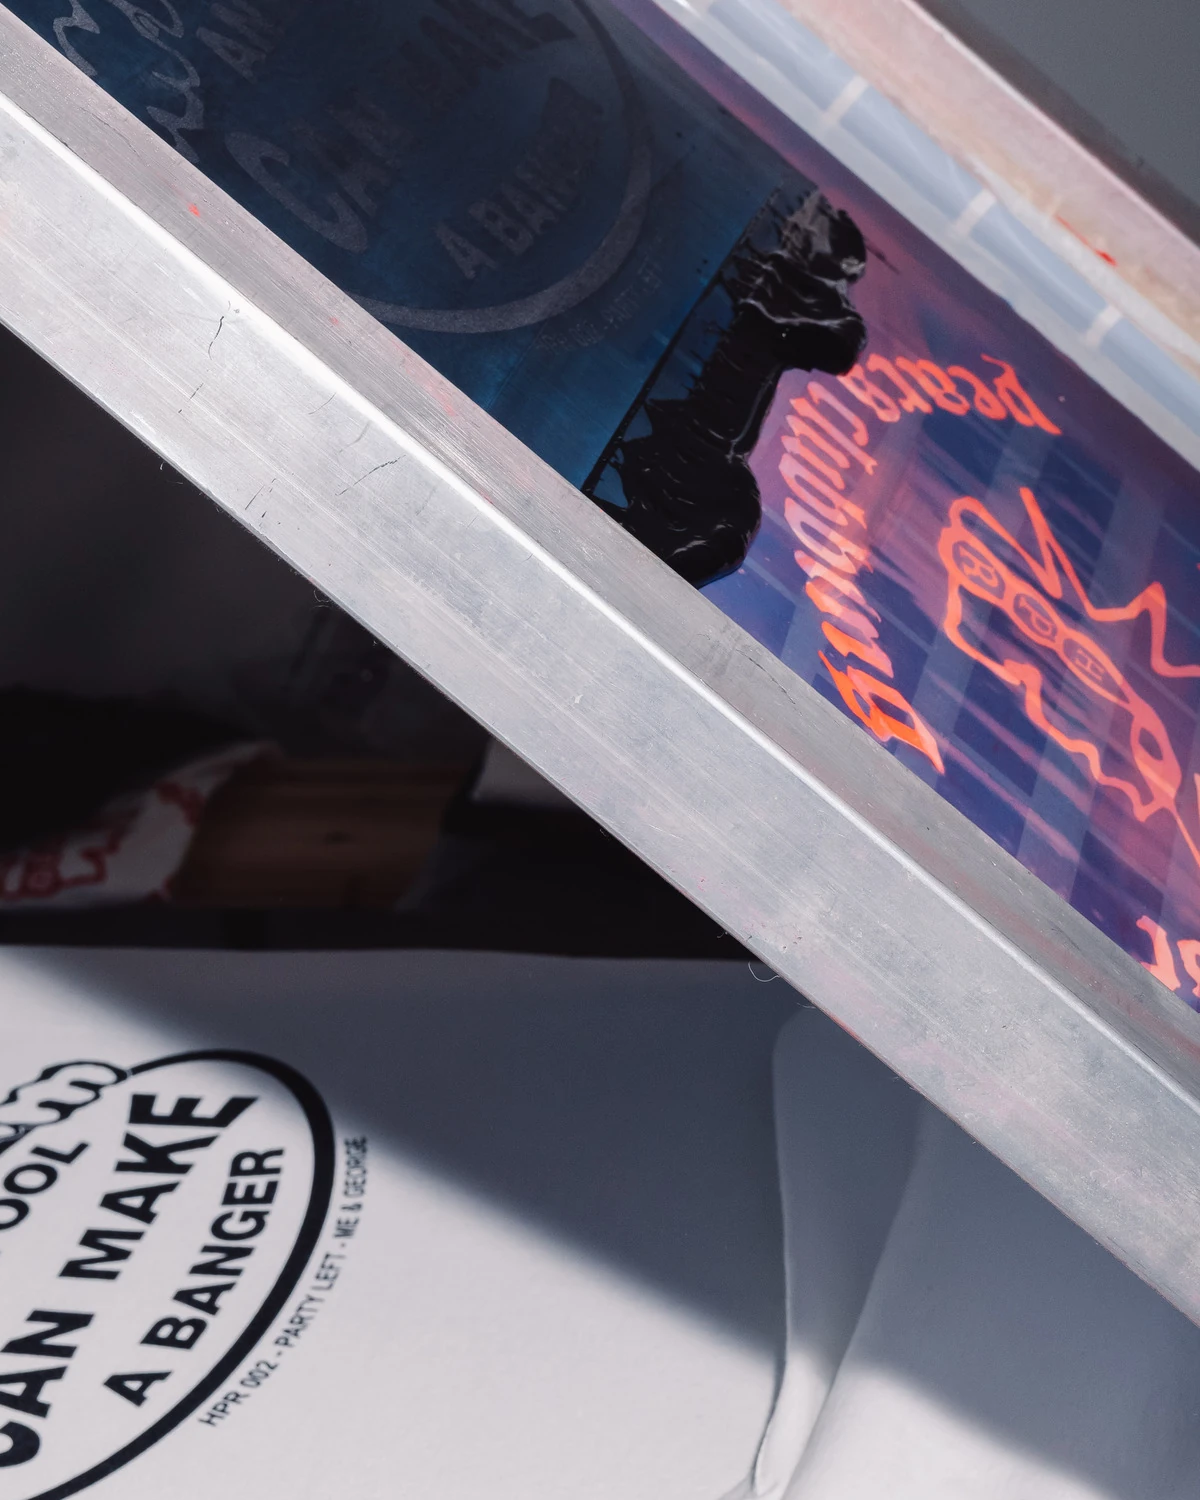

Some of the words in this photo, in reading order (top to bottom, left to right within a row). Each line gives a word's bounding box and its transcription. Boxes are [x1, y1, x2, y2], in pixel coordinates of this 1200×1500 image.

[59, 1093, 260, 1280] MAKE
[344, 1135, 368, 1199] GEORGE
[341, 1202, 363, 1213] &
[333, 1215, 360, 1240] ME
[103, 1370, 171, 1406] A
[140, 1148, 285, 1351] BANGER
[310, 1253, 347, 1292] LEFT
[274, 1294, 327, 1349] PARTY
[240, 1359, 279, 1389] 002
[197, 1389, 250, 1427] HPR
